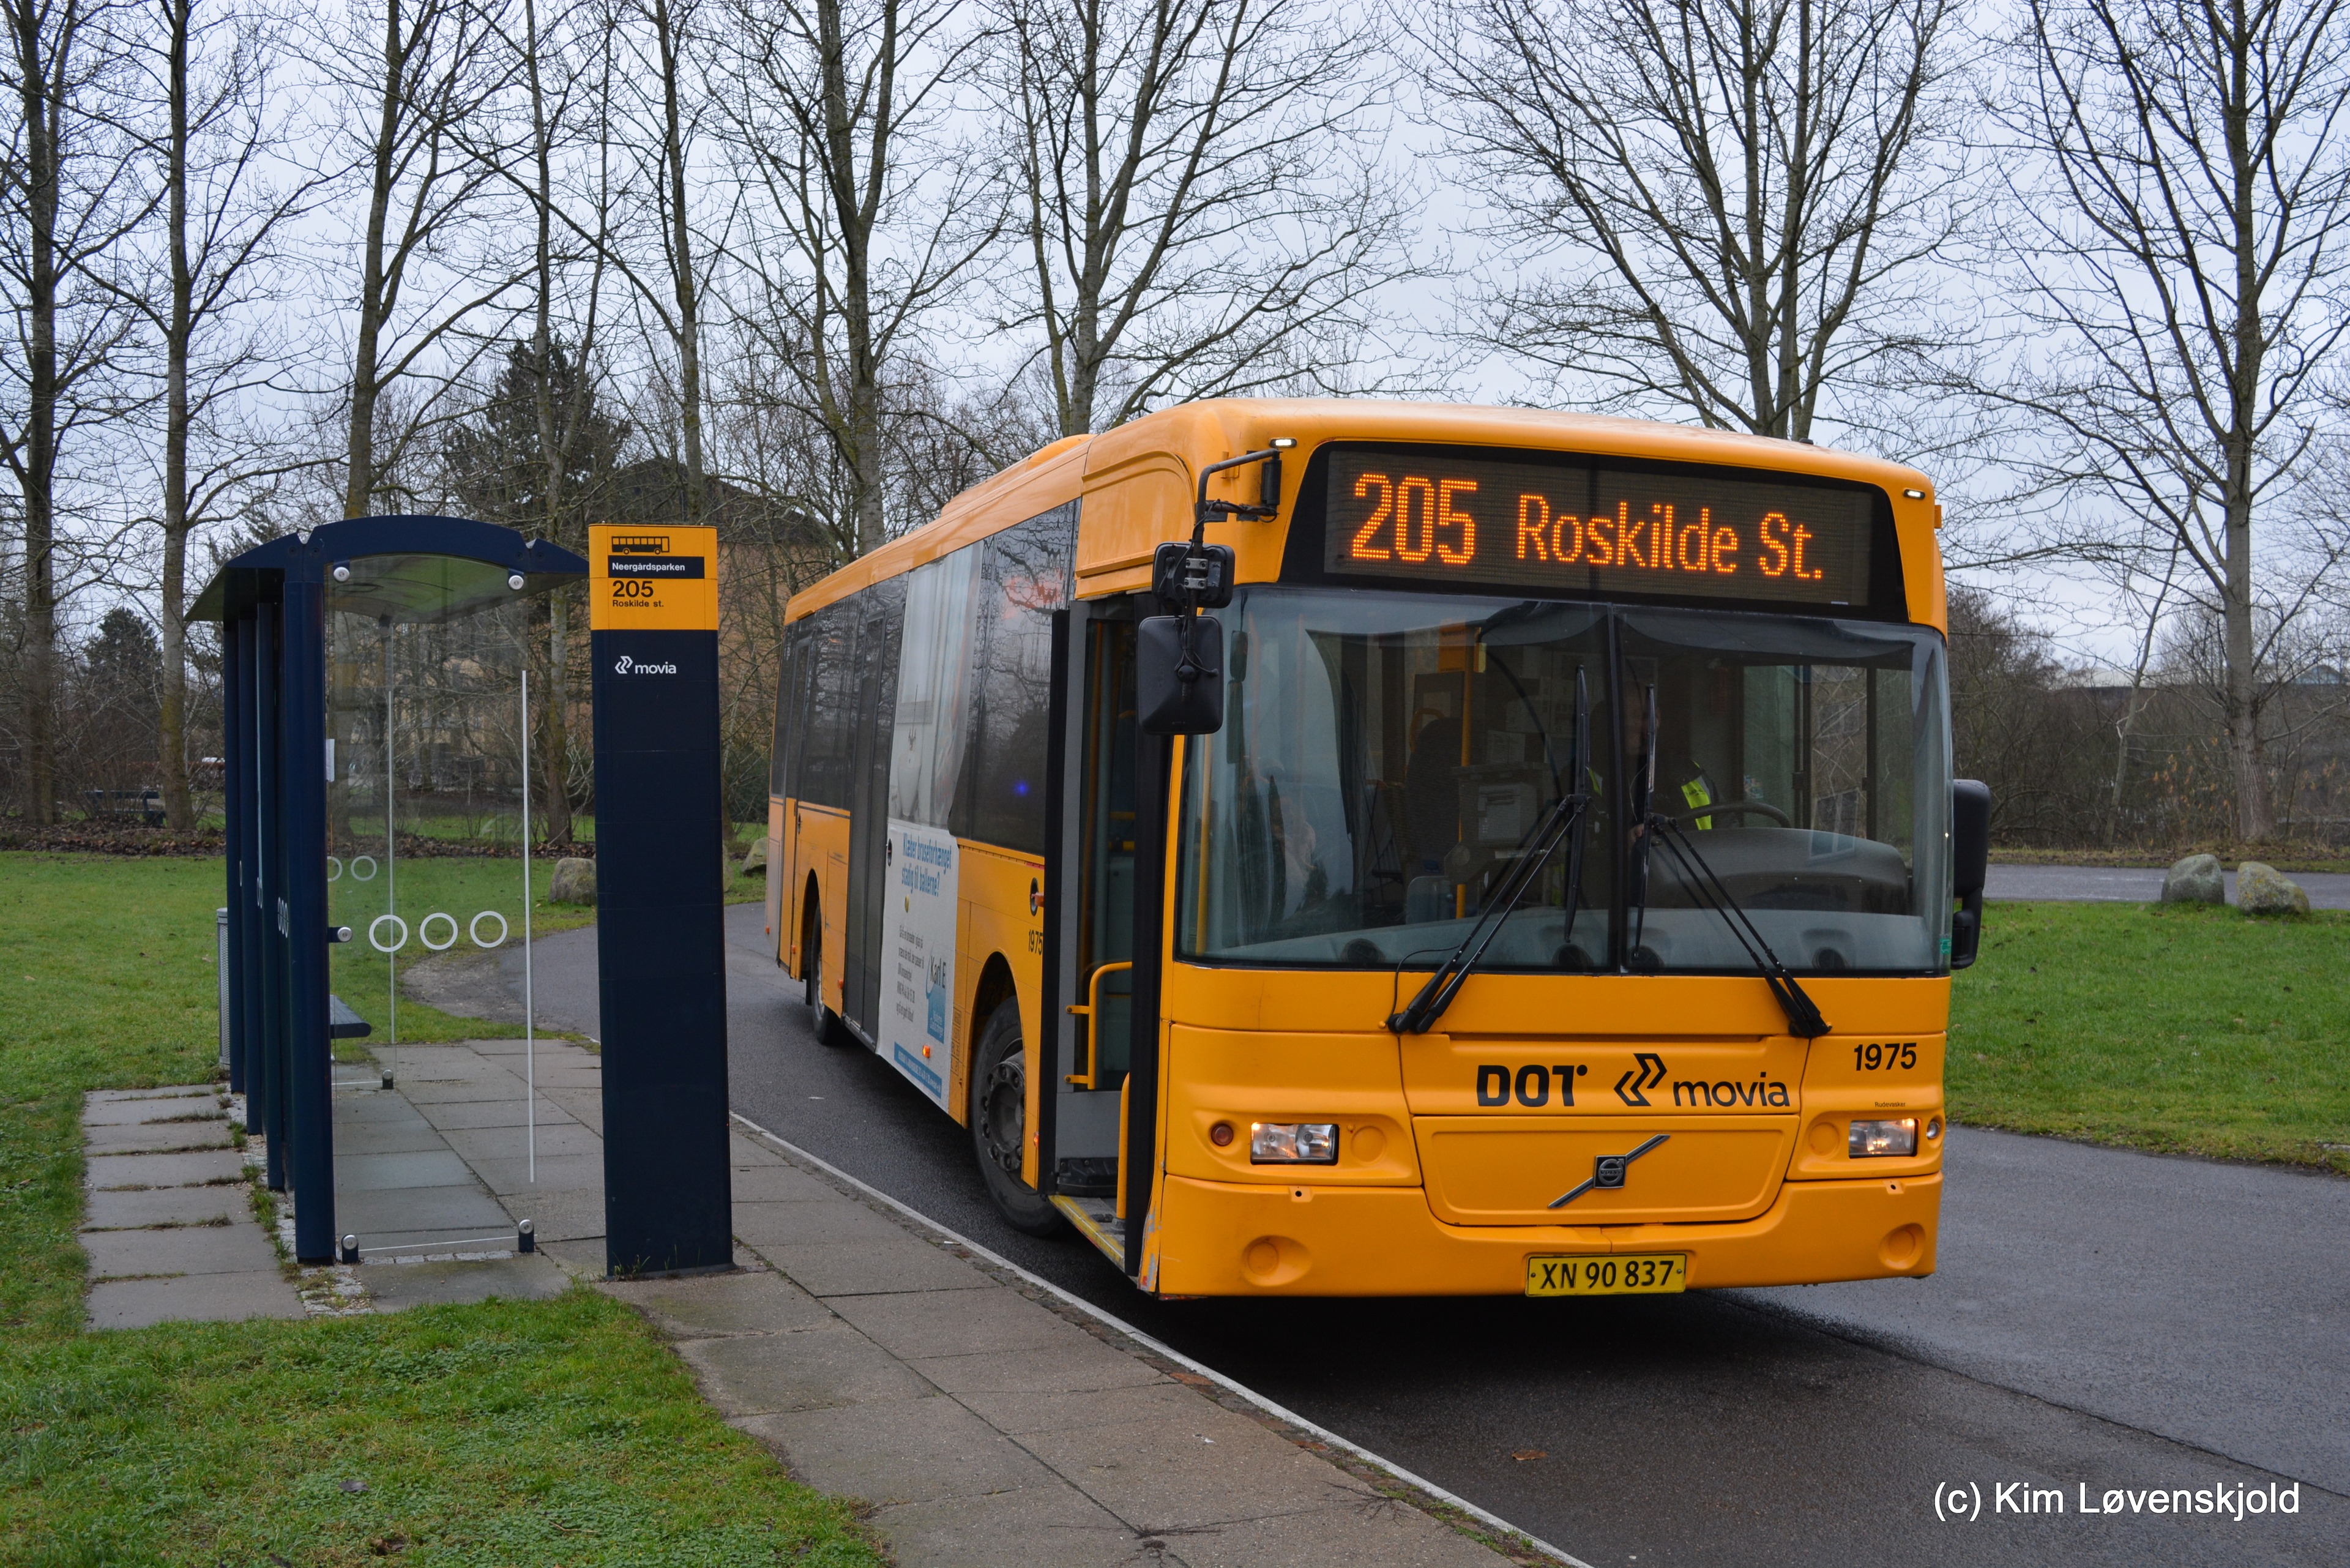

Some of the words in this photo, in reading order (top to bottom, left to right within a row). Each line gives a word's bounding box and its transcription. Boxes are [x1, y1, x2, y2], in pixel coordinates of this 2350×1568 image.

[1351, 472, 1477, 565] 205
[1516, 493, 1739, 573] Roskilde
[1758, 512, 1824, 580] St.
[612, 562, 685, 572] Neergårdsparken
[612, 580, 654, 598] 205
[612, 599, 649, 608] Roskilde
[635, 661, 677, 674] movia
[903, 832, 917, 859] Klæber
[1028, 929, 1043, 956] 1975
[930, 955, 942, 987] Karl
[1854, 1042, 1917, 1071] 1975
[1477, 1064, 1588, 1107] DOT
[1673, 1071, 1791, 1107] movia
[1541, 1262, 1578, 1290] XN
[1585, 1261, 1616, 1288] 90
[1624, 1260, 1674, 1288] 837
